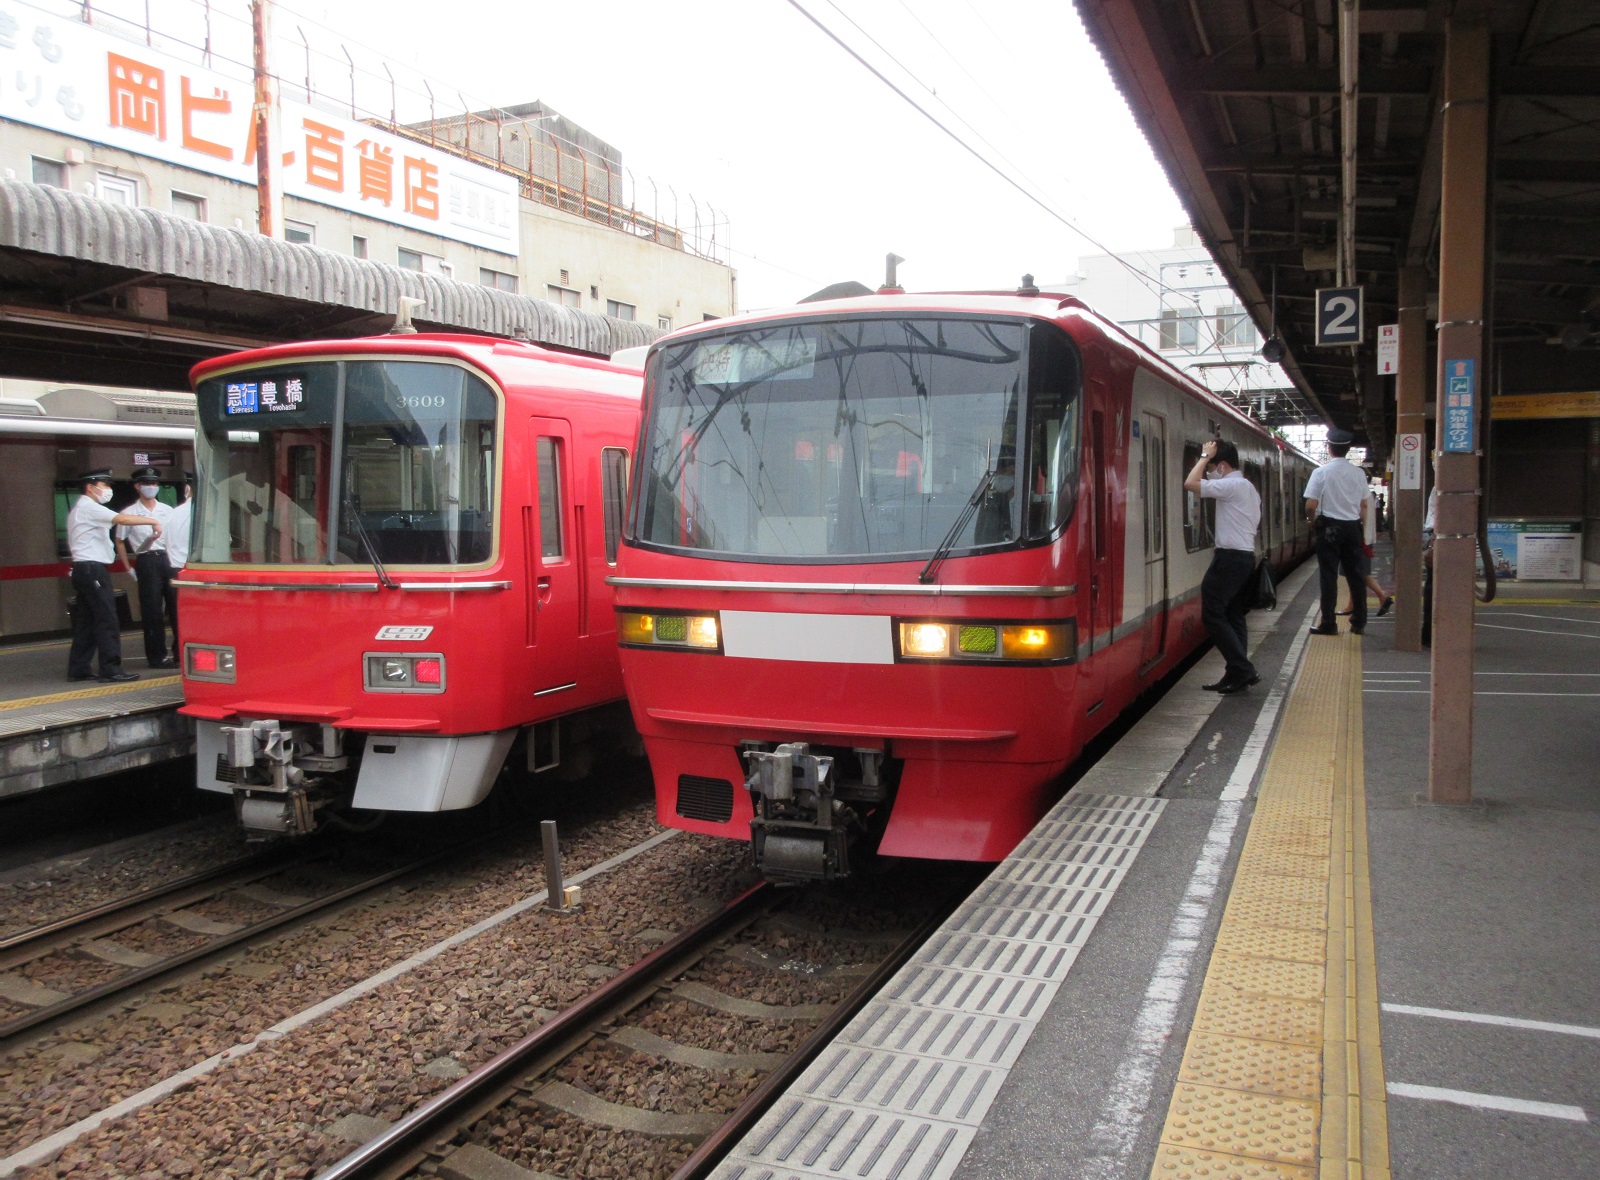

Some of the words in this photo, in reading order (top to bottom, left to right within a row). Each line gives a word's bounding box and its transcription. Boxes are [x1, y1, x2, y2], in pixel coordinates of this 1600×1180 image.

[1324, 296, 1356, 335] 2
[227, 383, 257, 407] 急行
[261, 378, 303, 405] 豊橋
[396, 394, 446, 409] 3609
[231, 406, 254, 414] Express
[268, 403, 297, 412] Toyohashi
